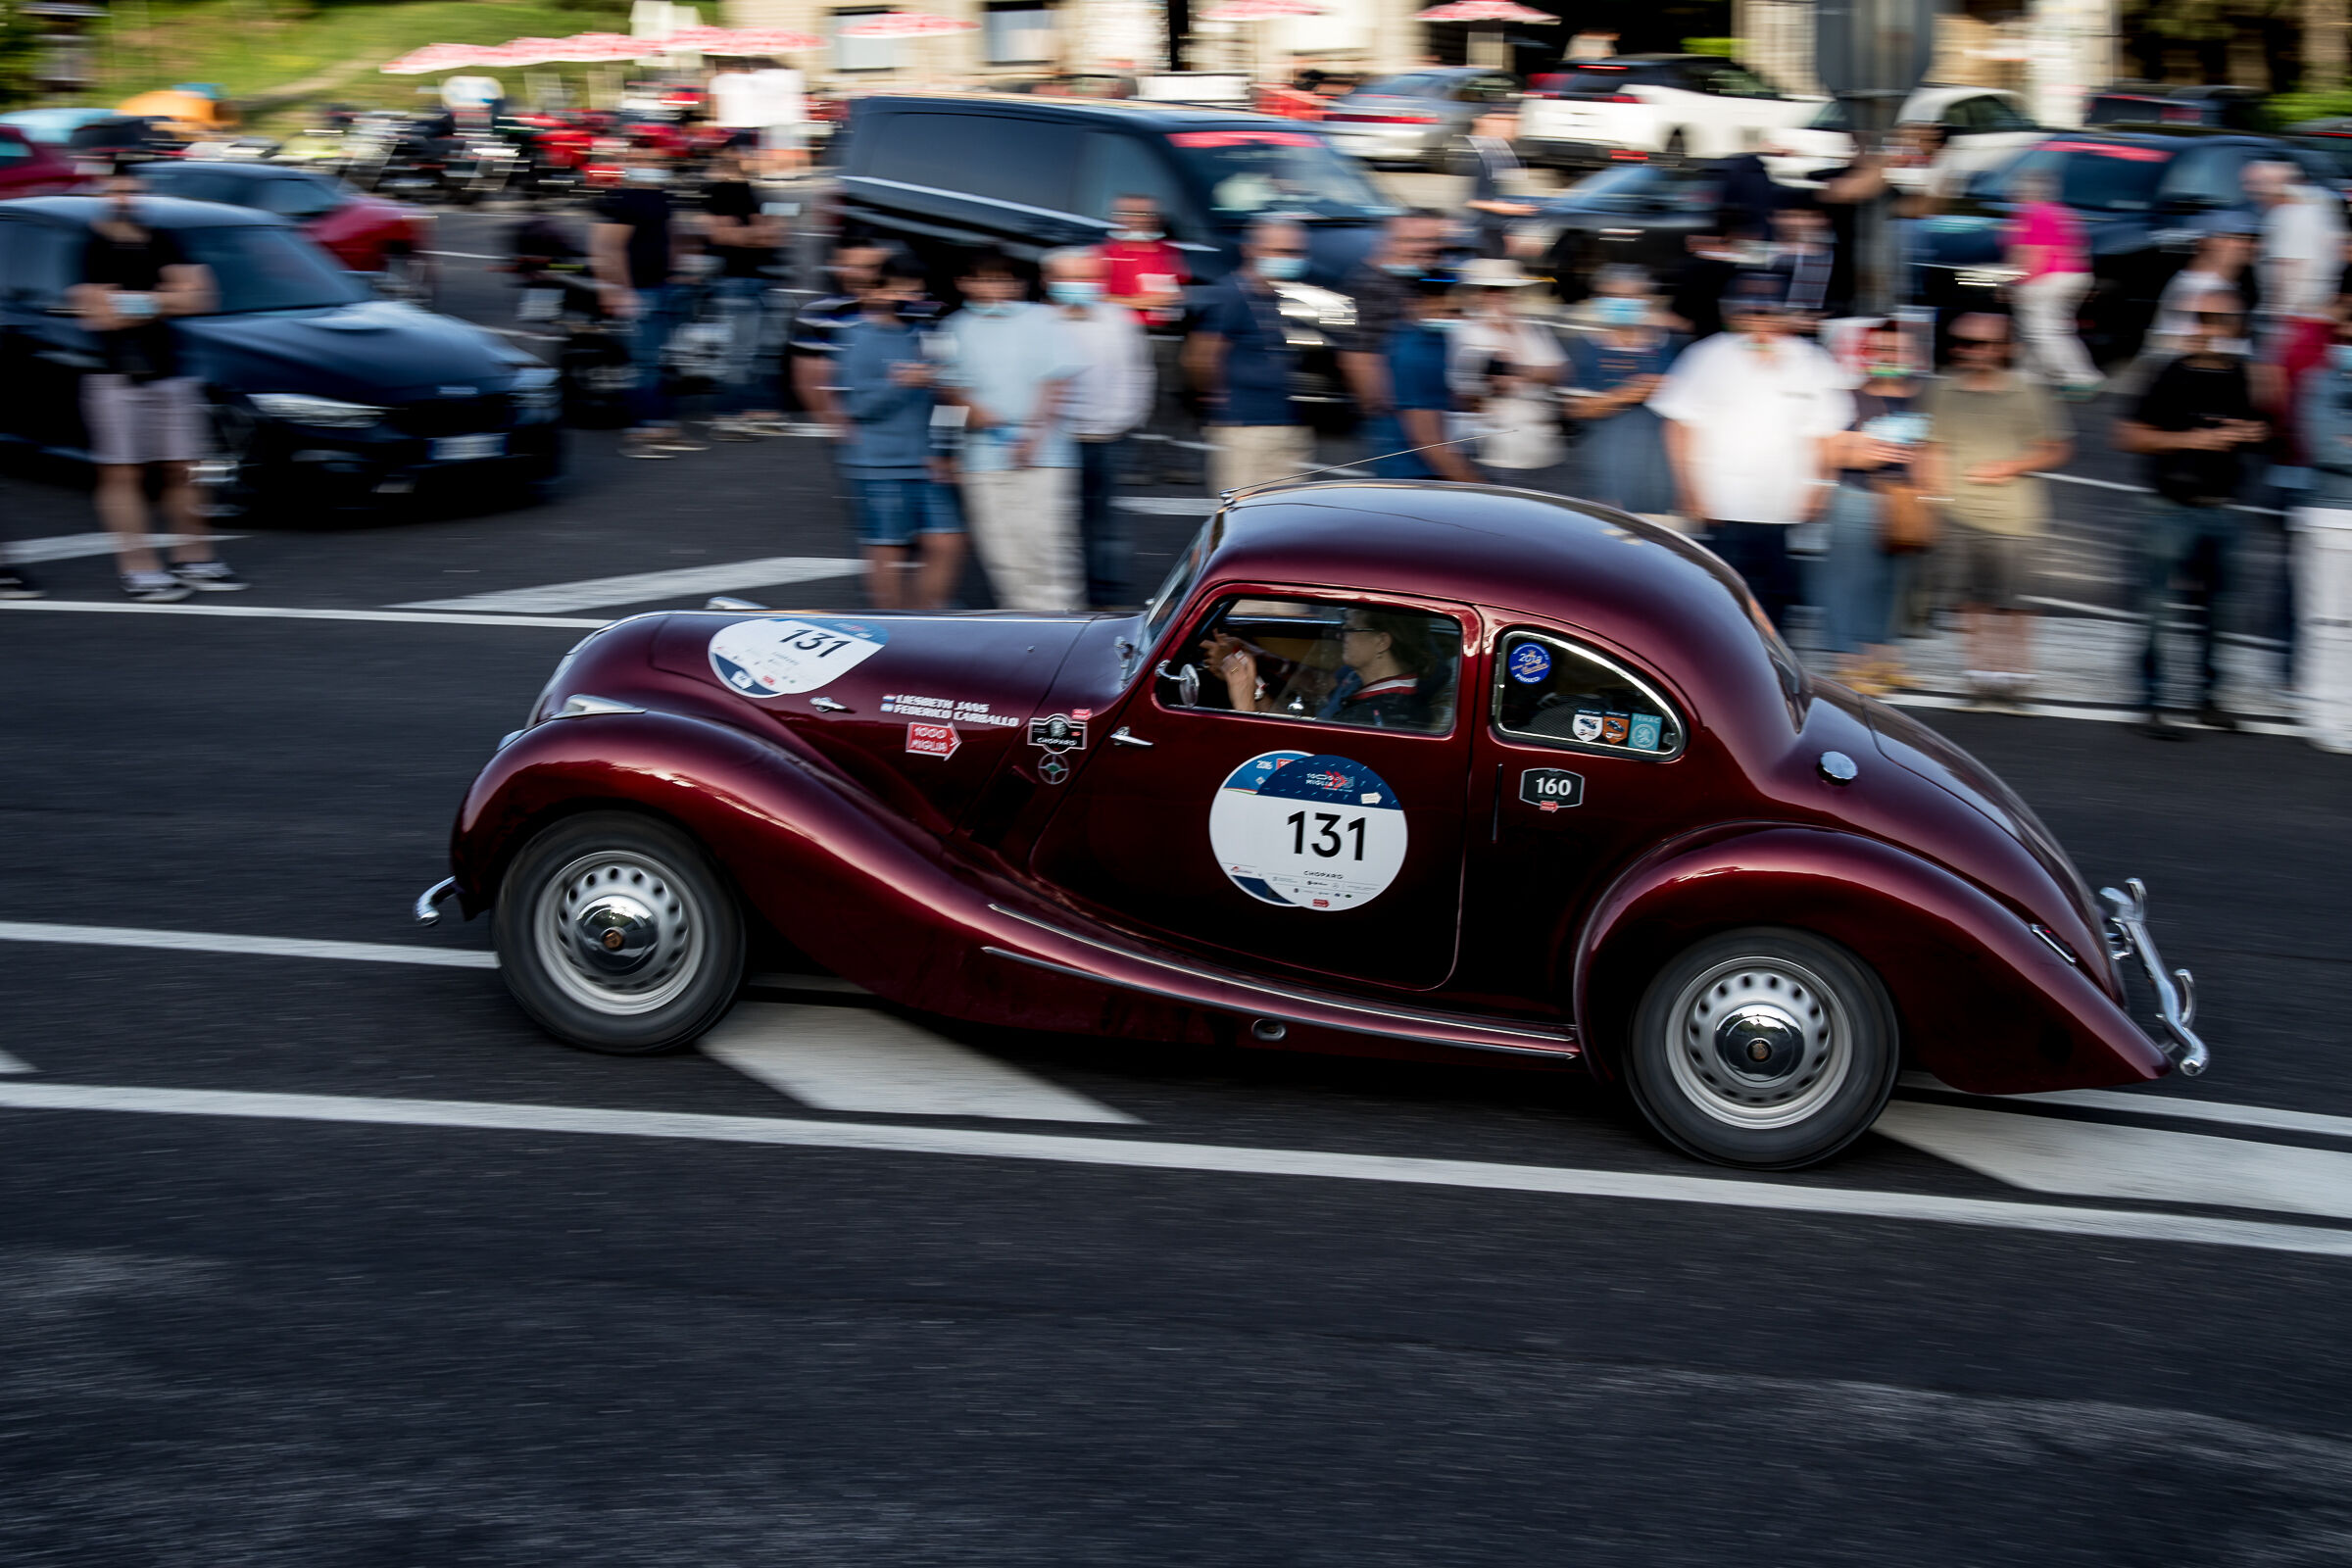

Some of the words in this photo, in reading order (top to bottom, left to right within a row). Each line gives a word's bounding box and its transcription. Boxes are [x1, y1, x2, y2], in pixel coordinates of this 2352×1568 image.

[778, 629, 853, 658] 131
[895, 694, 955, 709] LIESBETH
[954, 701, 990, 713] JANS
[893, 704, 954, 719] FEDERICO
[953, 710, 1020, 727] CARBALLO
[913, 726, 948, 739] 1000
[909, 739, 949, 752] MIGLIA
[1536, 777, 1572, 796] 160
[1287, 810, 1366, 861] 131
